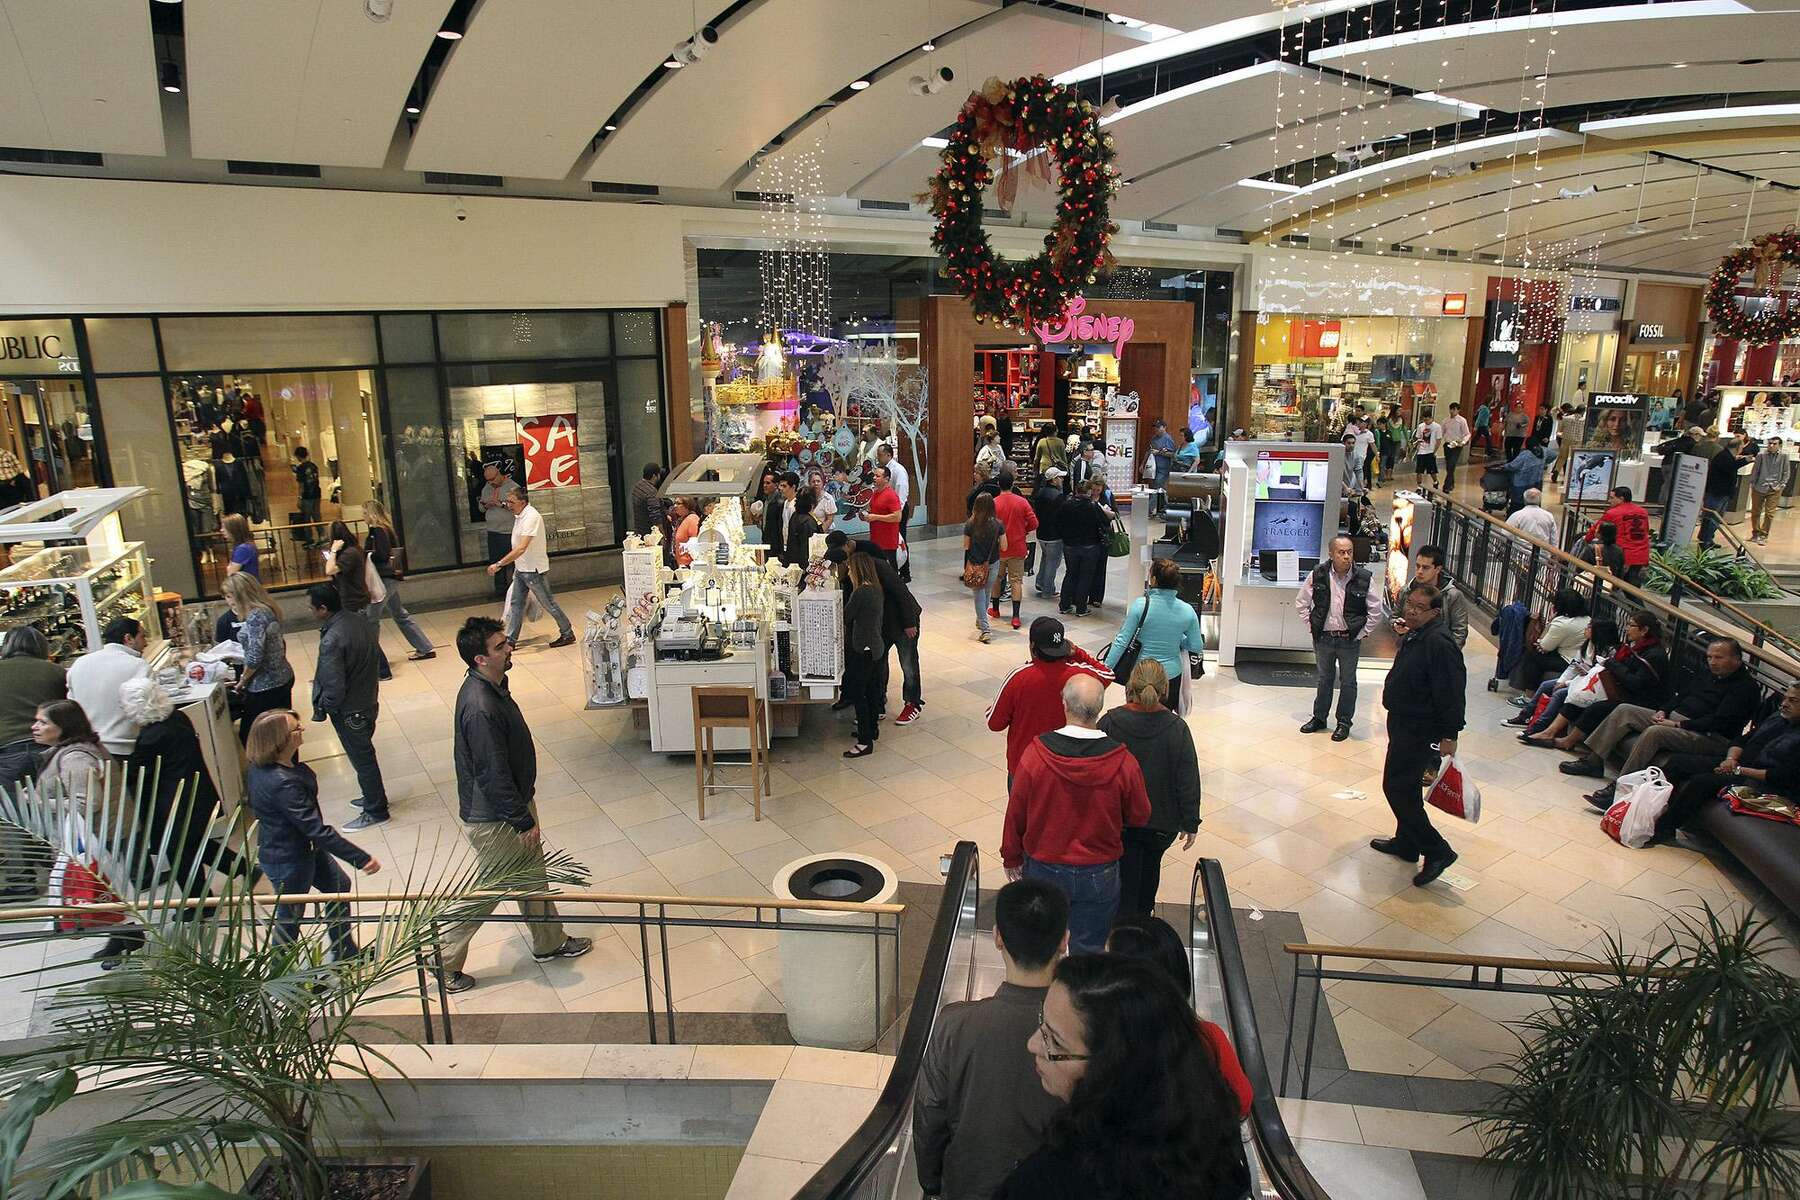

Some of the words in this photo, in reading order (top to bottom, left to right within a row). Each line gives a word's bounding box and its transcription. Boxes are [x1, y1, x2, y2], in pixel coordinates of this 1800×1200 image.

[1639, 324, 1664, 338] FOSSIL
[1595, 394, 1639, 405] proactiv
[1264, 527, 1311, 537] TRAEGER
